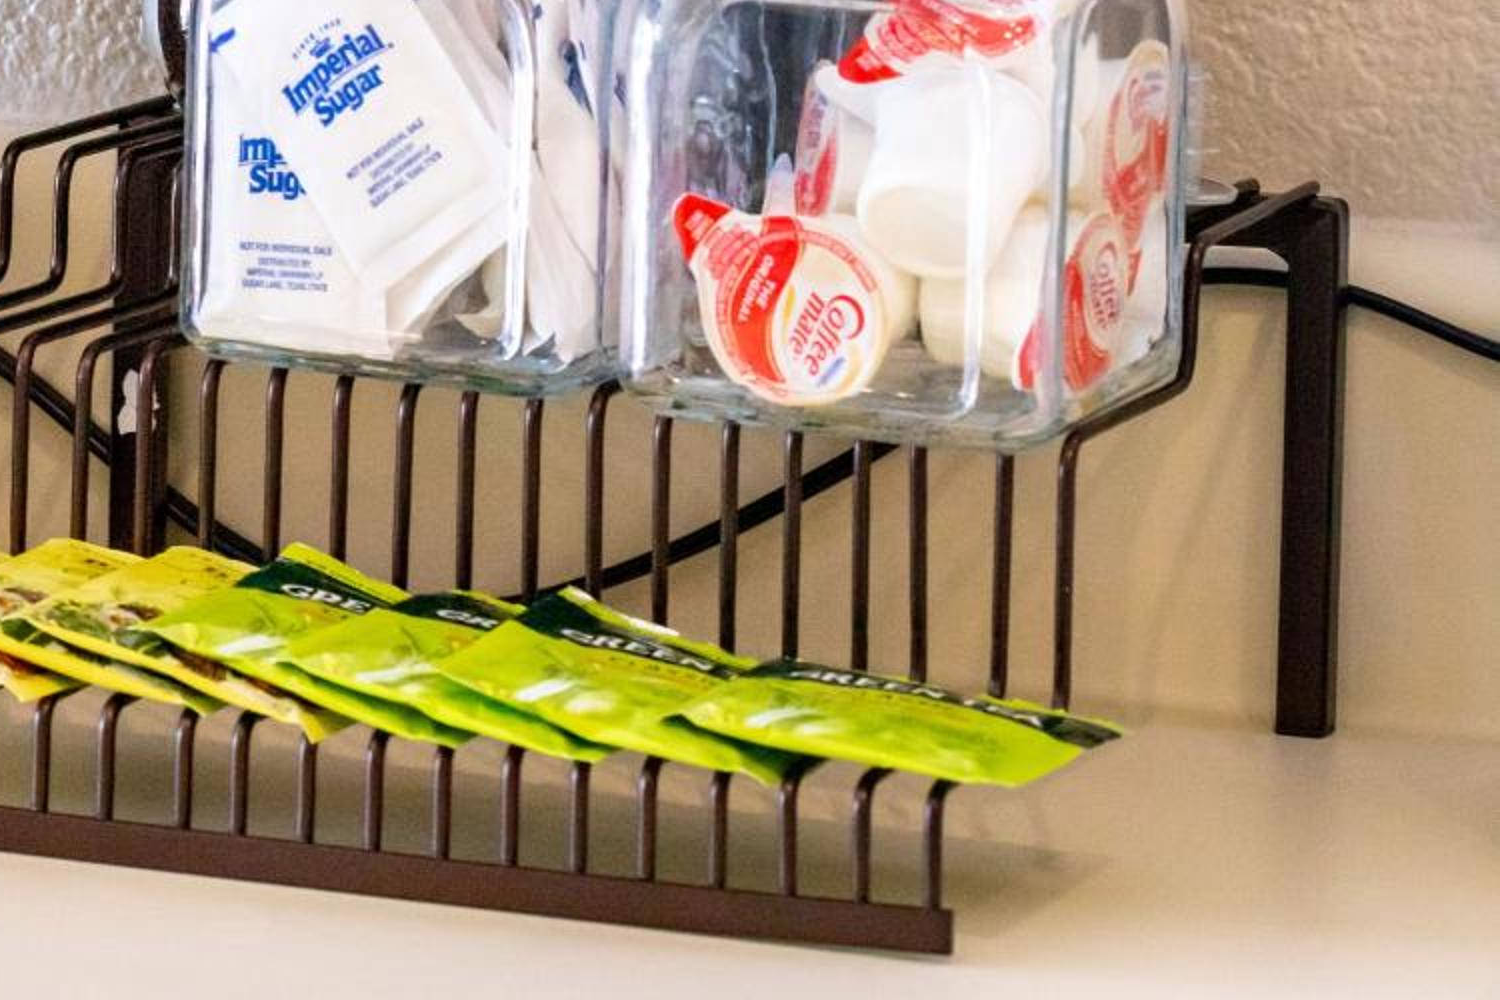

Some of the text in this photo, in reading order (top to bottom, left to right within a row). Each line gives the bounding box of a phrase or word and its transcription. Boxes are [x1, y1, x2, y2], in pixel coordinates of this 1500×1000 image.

[282, 23, 384, 113] Imperial
[314, 64, 384, 128] Sugar
[737, 253, 775, 324] ORIGINAL
[755, 278, 777, 312] THE
[790, 291, 825, 355] mate
[805, 294, 865, 376] Coffee
